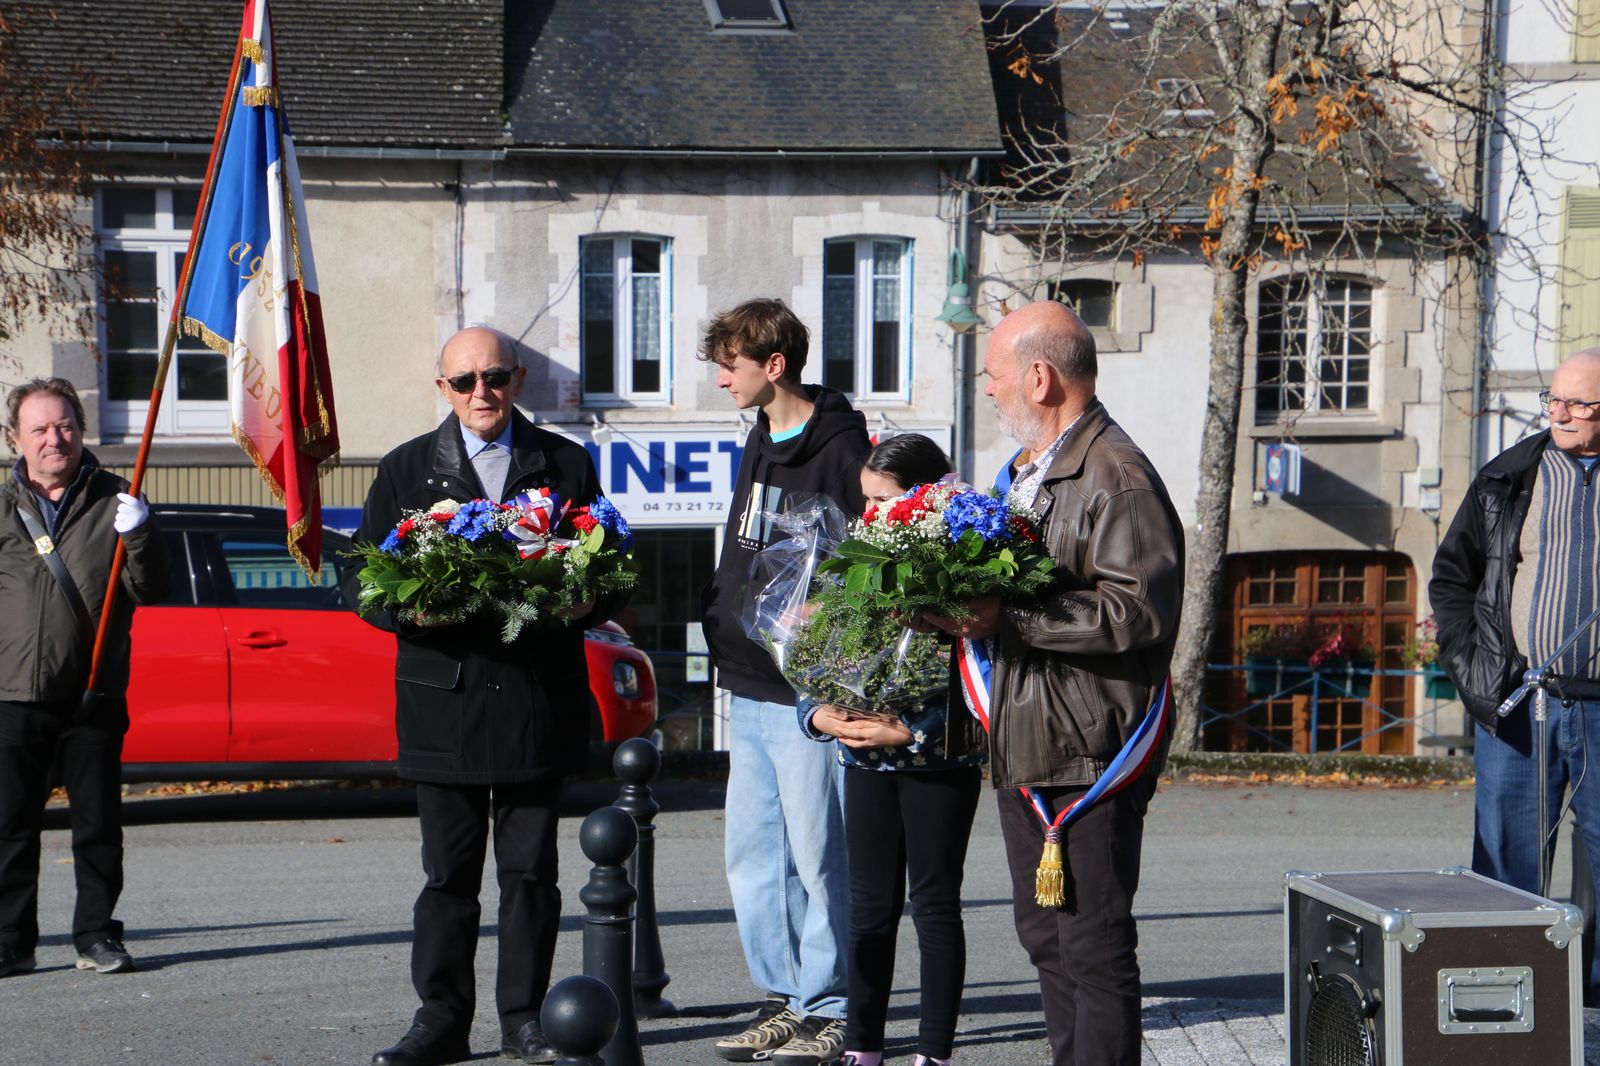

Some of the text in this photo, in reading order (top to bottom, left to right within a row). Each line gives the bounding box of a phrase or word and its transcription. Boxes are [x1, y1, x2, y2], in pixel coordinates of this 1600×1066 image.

[643, 502, 724, 512] 04 73 21 72
